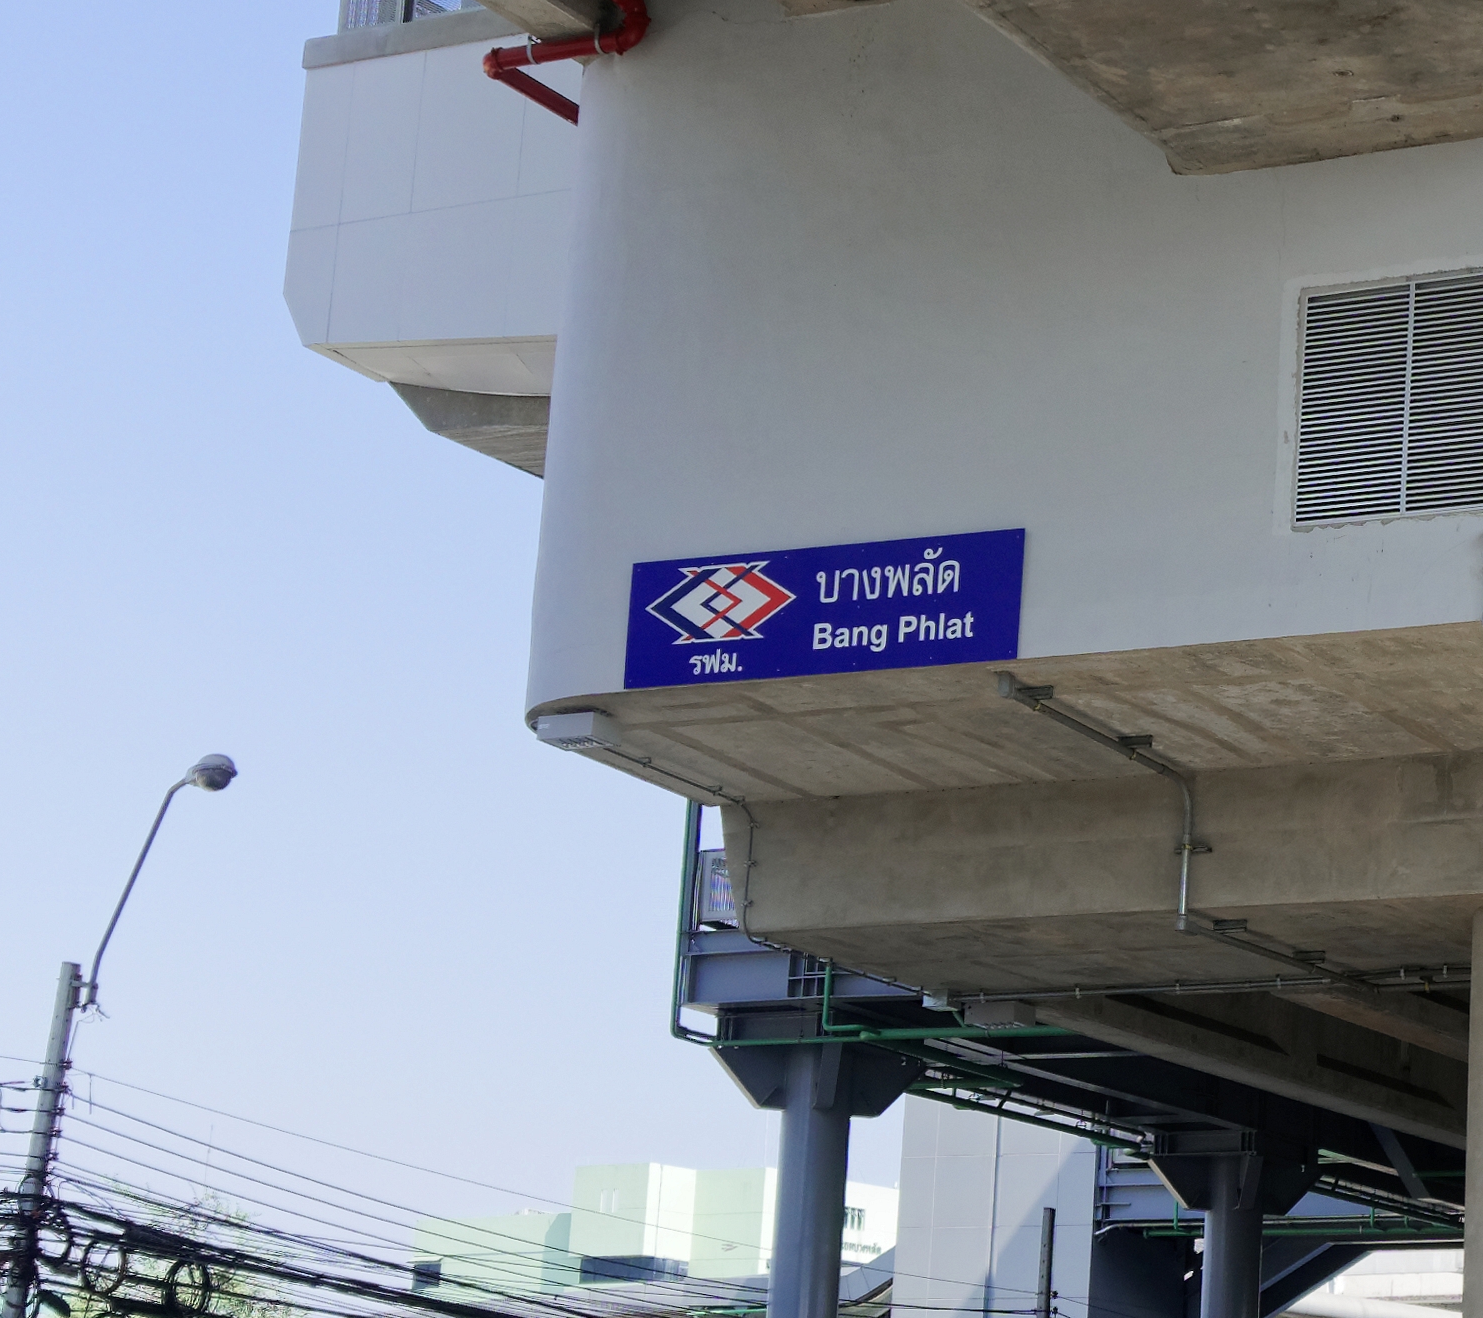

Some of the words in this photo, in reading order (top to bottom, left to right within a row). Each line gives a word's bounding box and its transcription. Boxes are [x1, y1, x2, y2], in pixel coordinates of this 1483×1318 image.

[817, 547, 960, 604] บางพลัด
[812, 622, 888, 652] Bang
[897, 611, 974, 643] Phlat
[689, 648, 743, 675] รฟม.
